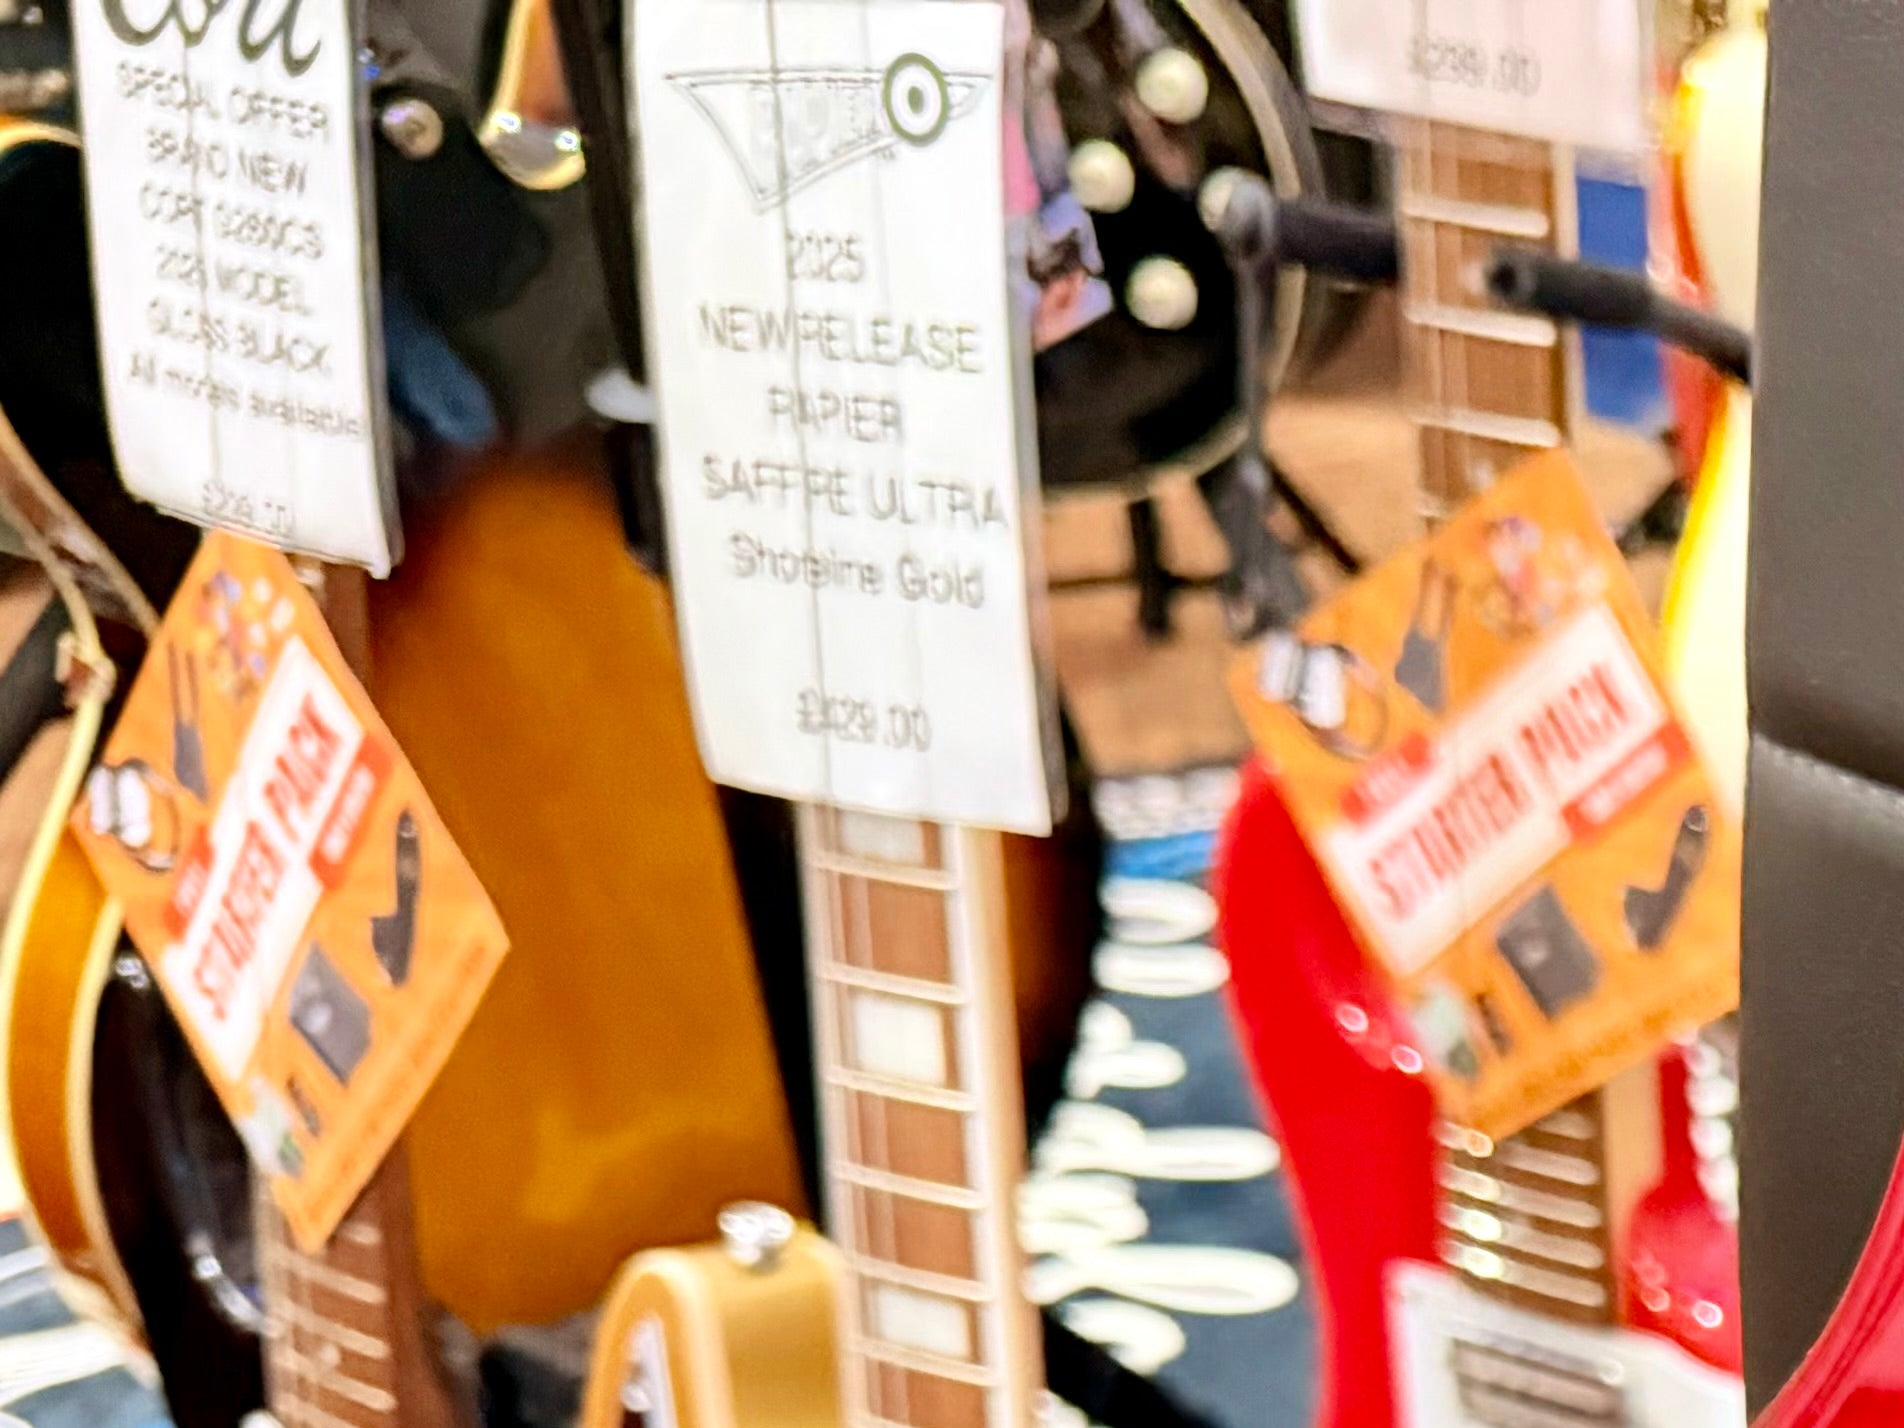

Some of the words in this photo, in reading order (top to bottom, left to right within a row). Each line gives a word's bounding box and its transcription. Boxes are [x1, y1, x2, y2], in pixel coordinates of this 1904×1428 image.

[228, 85, 331, 143] OFFER
[238, 147, 309, 196] NEW
[786, 229, 867, 283] 2025
[215, 256, 314, 317] MODEL
[237, 322, 331, 377] BLACK
[699, 301, 795, 352] NEW
[796, 309, 985, 375] RELEASE
[767, 386, 905, 443] RAPIER
[868, 469, 1010, 530] ULTRA
[898, 551, 986, 609] Gold
[1368, 750, 1530, 921] STARTER
[1517, 661, 1632, 787] PACK
[193, 820, 286, 1021] STARTER
[261, 691, 344, 843] PACK
